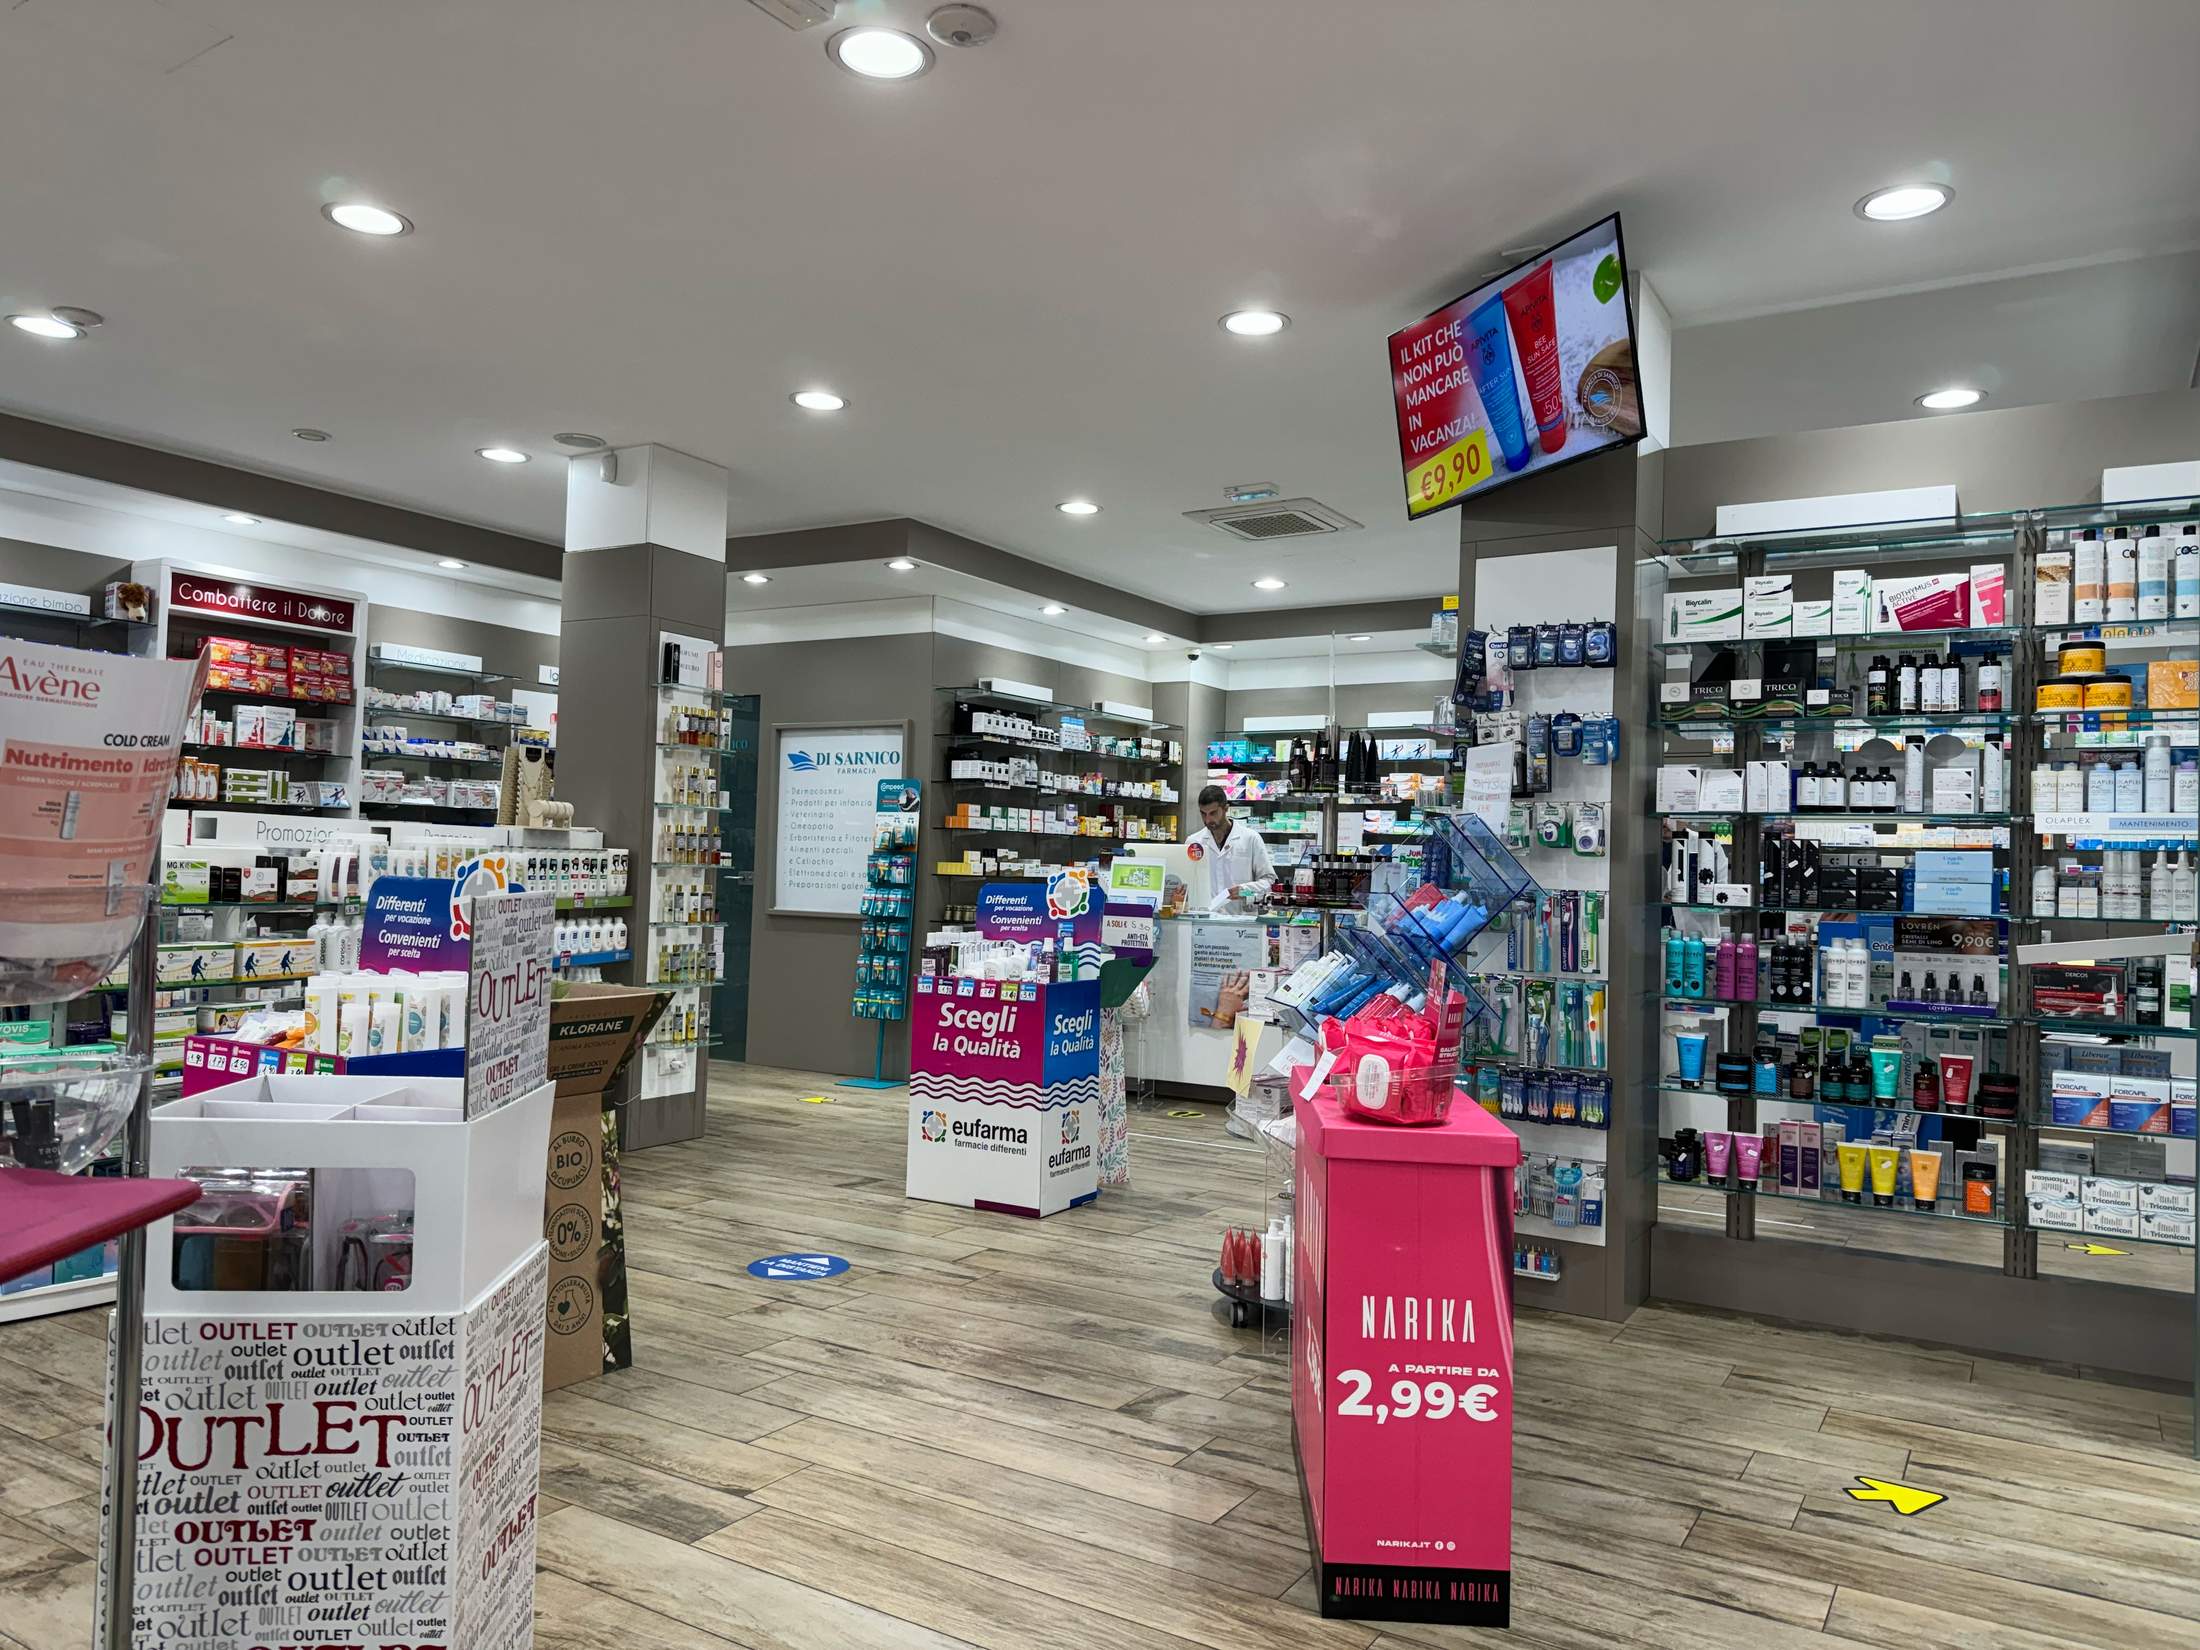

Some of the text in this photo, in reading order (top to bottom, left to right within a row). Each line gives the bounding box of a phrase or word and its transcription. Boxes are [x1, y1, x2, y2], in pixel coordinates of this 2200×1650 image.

[1400, 318, 1463, 365] IL KIT CHE
[1534, 334, 1547, 349] BEE
[1527, 350, 1541, 364] SUN
[1404, 344, 1464, 388] NON PUÒ
[1406, 366, 1470, 410] MANCARE
[1478, 378, 1499, 394] AFTER
[1408, 415, 1422, 432] IN
[1411, 414, 1475, 454] VACANZA!
[1420, 443, 1481, 502] €9,90
[1888, 580, 1932, 602] BIOTHYMUS
[42, 596, 83, 613] bimbo
[179, 583, 345, 624] Combattere il Dolore
[23, 658, 104, 676] EAU THERMALE
[397, 650, 468, 669] Medicazione
[0, 656, 100, 700] Avène
[1693, 686, 1724, 694] TRICO
[1764, 684, 1796, 692] TRICO
[104, 734, 170, 748] COLD CREAM
[5, 748, 133, 773] Nutrimento
[816, 750, 900, 766] DI SARNICO
[824, 800, 837, 808] per
[2045, 816, 2091, 825] OLAPLEX
[788, 882, 839, 890] Preparazioni
[376, 896, 426, 913] Differenti
[986, 895, 1027, 906] Differenti
[384, 912, 432, 925] per vocazione
[990, 915, 1042, 926] Convenienti
[1112, 920, 1122, 928] SOLI
[1012, 924, 1028, 932] scelta
[378, 929, 442, 948] Convenienti
[1121, 939, 1148, 948] PROTETTIVA
[1952, 934, 1994, 948] 9,90€
[388, 948, 420, 959] per scelta
[478, 958, 547, 1023] OUTLET
[560, 1020, 624, 1036] KLORANE
[938, 1002, 1018, 1038] Scegli
[1053, 1009, 1093, 1036] Scegli
[932, 1032, 1021, 1059] la Qualità
[1050, 1035, 1094, 1056] la Qualità
[952, 1119, 1028, 1144] eufarma
[954, 1139, 1027, 1156] farmacie differenti
[1048, 1144, 1091, 1168] eufarma
[556, 1152, 582, 1169] BIO
[1050, 1160, 1091, 1178] farmacie differenti
[2032, 1175, 2070, 1184] Triconicon
[2092, 1197, 2131, 1207] Triconicon
[2150, 1202, 2190, 1213] Triconicon
[2038, 1218, 2077, 1228] Triconicon
[2094, 1224, 2133, 1235] Triconicon
[558, 1220, 581, 1245] 0%
[2150, 1232, 2190, 1242] Triconicon
[392, 1316, 457, 1337] outlet
[1362, 1296, 1476, 1344] NARIKA
[200, 1323, 298, 1340] OUTLET
[303, 1324, 390, 1338] OUTLET
[231, 1342, 287, 1357] outlet
[294, 1340, 395, 1367] outlet
[145, 1348, 224, 1372] outlet
[1388, 1364, 1500, 1378] A PARTIRE DA
[314, 1377, 378, 1396] outlet
[463, 1329, 532, 1434] OUTLET
[165, 1382, 258, 1411] outlet
[364, 1390, 426, 1412] outlet
[424, 1391, 455, 1401] outlet
[1336, 1368, 1500, 1424] 2,99€
[409, 1416, 454, 1426] OUTLET
[256, 1458, 322, 1480] outlet
[324, 1460, 367, 1473] outlet
[248, 1486, 322, 1500] OUTLET
[409, 1481, 449, 1493] outlet
[155, 1486, 242, 1516] outlet
[292, 1503, 322, 1512] outlet
[174, 1518, 317, 1545] OUTLET
[320, 1522, 382, 1542] outlet
[390, 1523, 450, 1541] outlet
[194, 1546, 294, 1566] OUTLET
[298, 1547, 384, 1562] OUTLET
[385, 1541, 448, 1562] outlet
[226, 1567, 282, 1583] outlet
[288, 1563, 388, 1592] outlet
[1336, 1576, 1499, 1602] NARIKA NARIKA NARIKA
[308, 1602, 370, 1622] outlet
[157, 1608, 250, 1640] outlet
[357, 1616, 416, 1636] outlet
[293, 1630, 352, 1641] OUTLET
